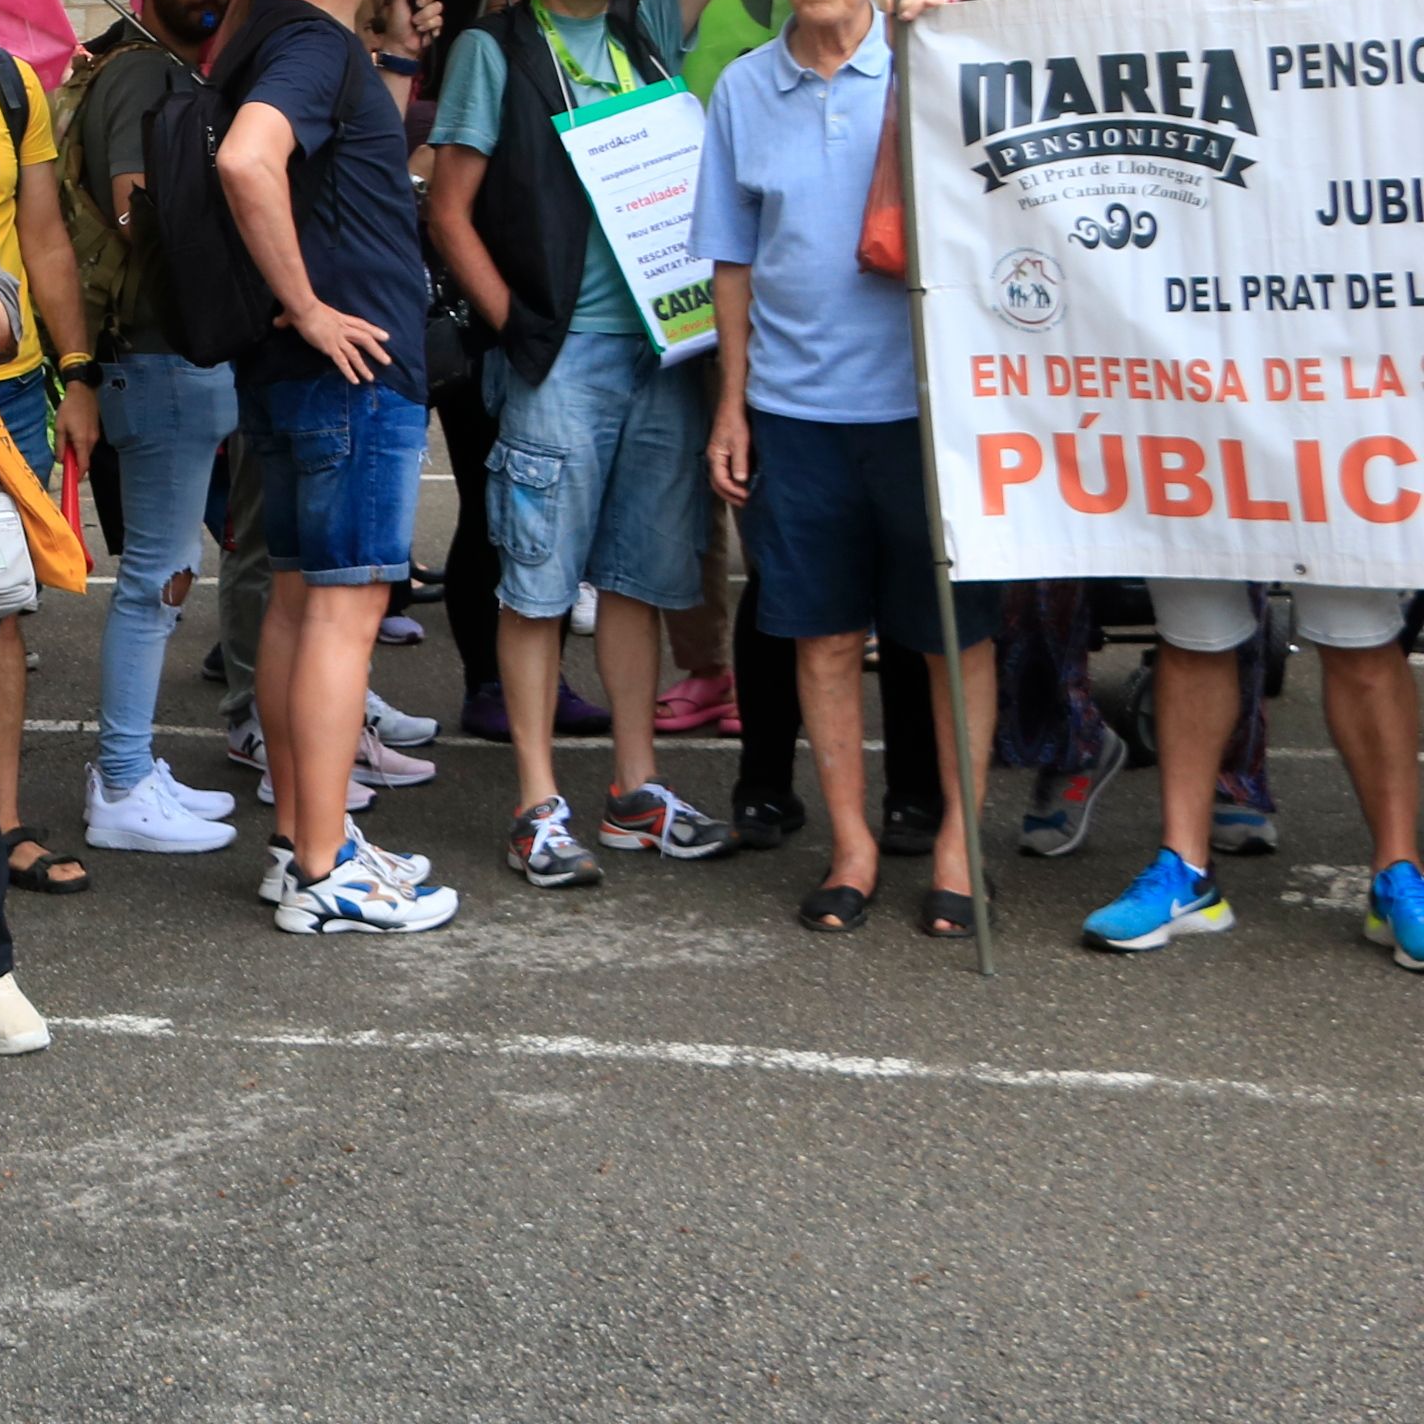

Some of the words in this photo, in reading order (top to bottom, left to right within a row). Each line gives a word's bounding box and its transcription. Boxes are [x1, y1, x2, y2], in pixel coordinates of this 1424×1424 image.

[959, 49, 1259, 147] MAREA
[1000, 127, 1221, 167] PENSIONISTA
[1017, 175, 1040, 191] El
[1044, 165, 1084, 183] Prat
[1090, 161, 1110, 176] de
[1117, 160, 1204, 187] Llobregat
[1017, 193, 1058, 211] Plaza
[1062, 182, 1136, 200] Cataluña
[1141, 182, 1209, 210] (Zonilla)
[1165, 275, 1231, 312] DEL
[1242, 273, 1335, 312] PRAT
[1345, 272, 1397, 310] DE
[970, 354, 1030, 397] EN
[1044, 354, 1249, 403] DEFENSA
[1262, 357, 1326, 402] DE
[1342, 354, 1406, 400] LA
